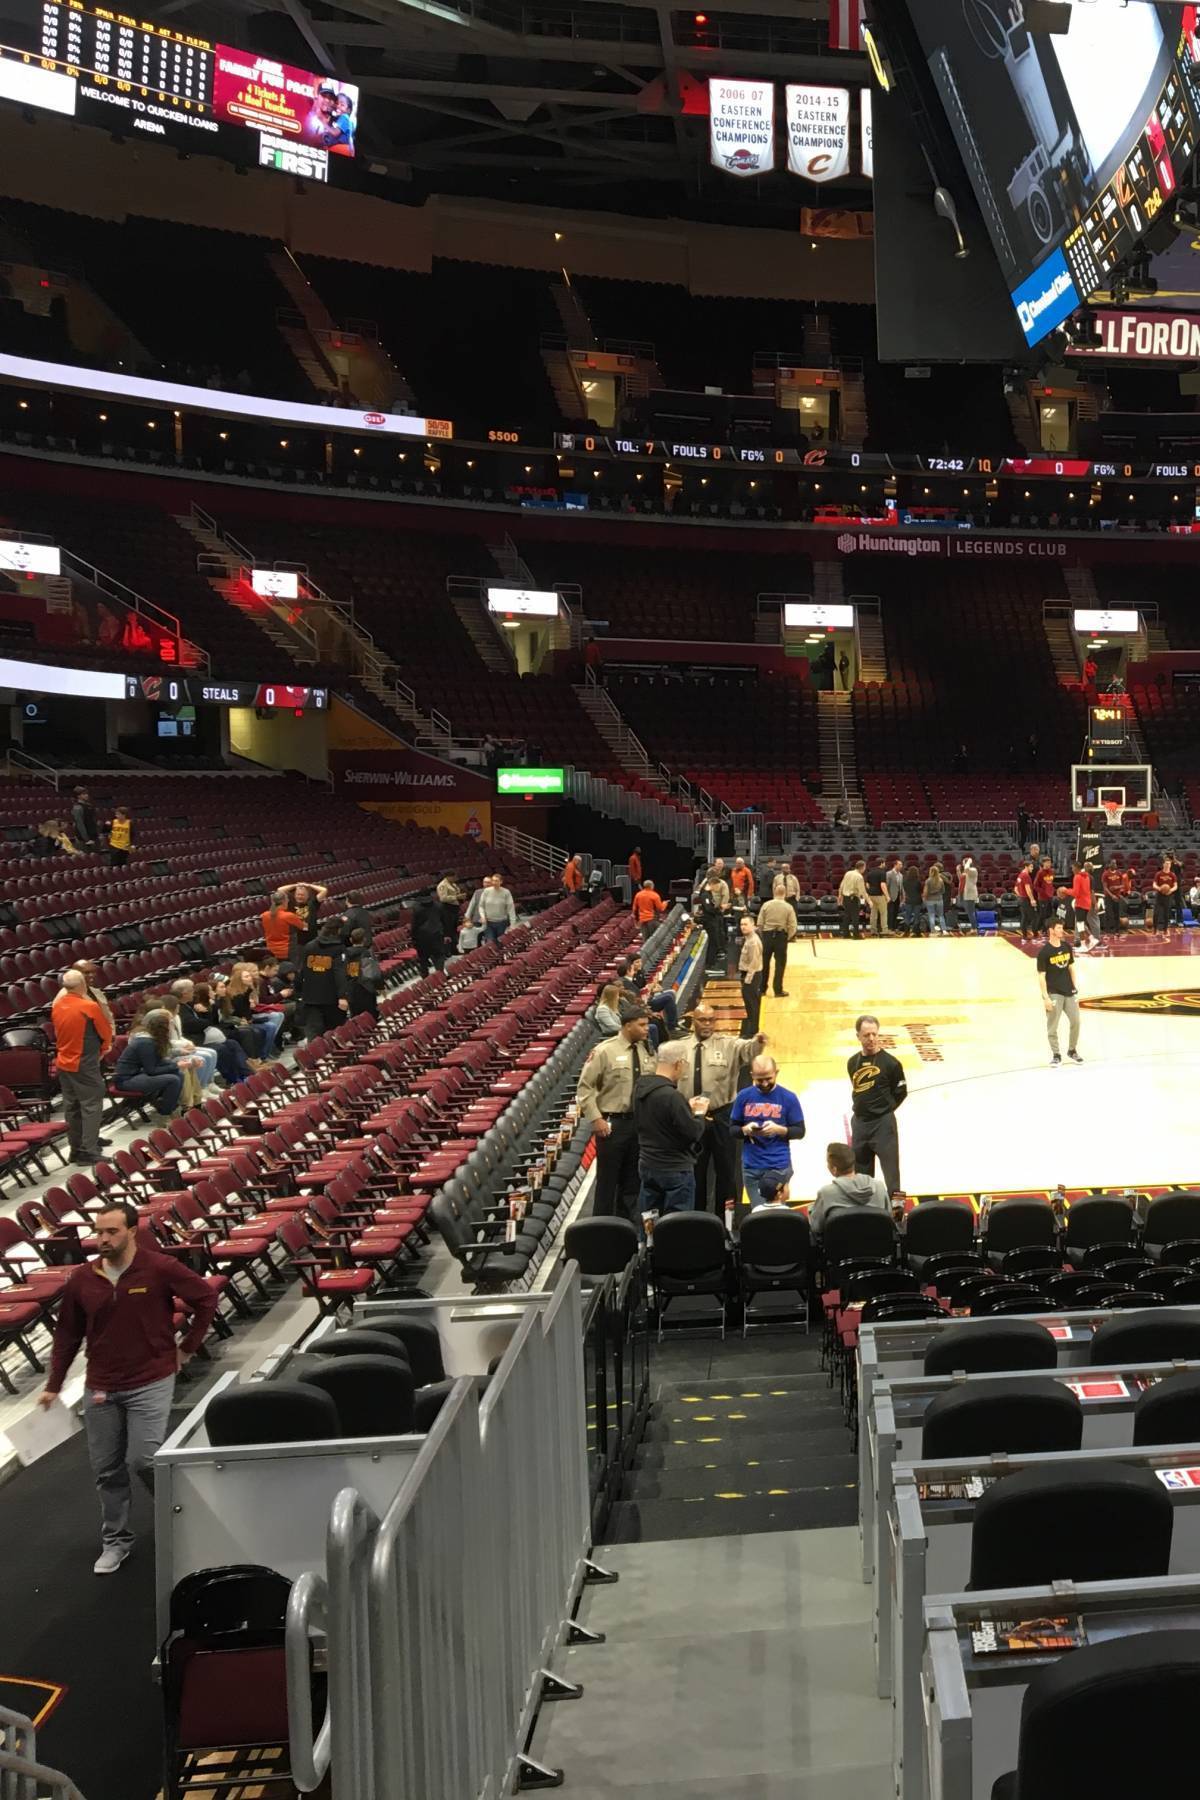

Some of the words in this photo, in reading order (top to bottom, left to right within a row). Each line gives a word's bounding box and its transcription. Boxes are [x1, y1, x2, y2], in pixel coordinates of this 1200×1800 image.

[80, 86, 130, 109] WELCOME
[132, 100, 146, 112] TO
[147, 104, 188, 122] QUICKEN
[189, 117, 219, 132] LOANS
[722, 104, 762, 116] EASTERN
[798, 110, 837, 122] EASTERN
[134, 119, 166, 135] ARENA
[714, 118, 770, 130] CONFERENCE
[791, 122, 846, 136] CONFERENCE
[716, 131, 768, 144] CHAMPIONS
[793, 136, 844, 148] CHAMPIONS
[428, 420, 449, 430] 50/50
[488, 431, 518, 442] $500
[585, 438, 594, 450] 0
[616, 441, 639, 452] TOL:
[646, 442, 654, 454] 7
[673, 445, 706, 457] FOULS
[713, 448, 721, 460] 0
[741, 450, 764, 462] FG%
[776, 450, 784, 462] 0
[852, 454, 860, 466] 0
[928, 458, 963, 470] 72:42
[1056, 462, 1063, 474] 0
[1094, 465, 1116, 476] FG%
[1124, 464, 1132, 476] 0
[1156, 466, 1188, 476] FOULS
[859, 534, 940, 556] Huntington
[956, 540, 1024, 554] LEGENDS
[1028, 543, 1067, 556] CLUB
[130, 686, 135, 696] 0
[170, 682, 178, 700] 0
[202, 687, 239, 700] STEALS
[266, 688, 275, 704] 0
[316, 698, 322, 708] 0
[1093, 708, 1121, 720] 72:41
[914, 1045, 945, 1062] Loans
[744, 1102, 782, 1118] LOVE
